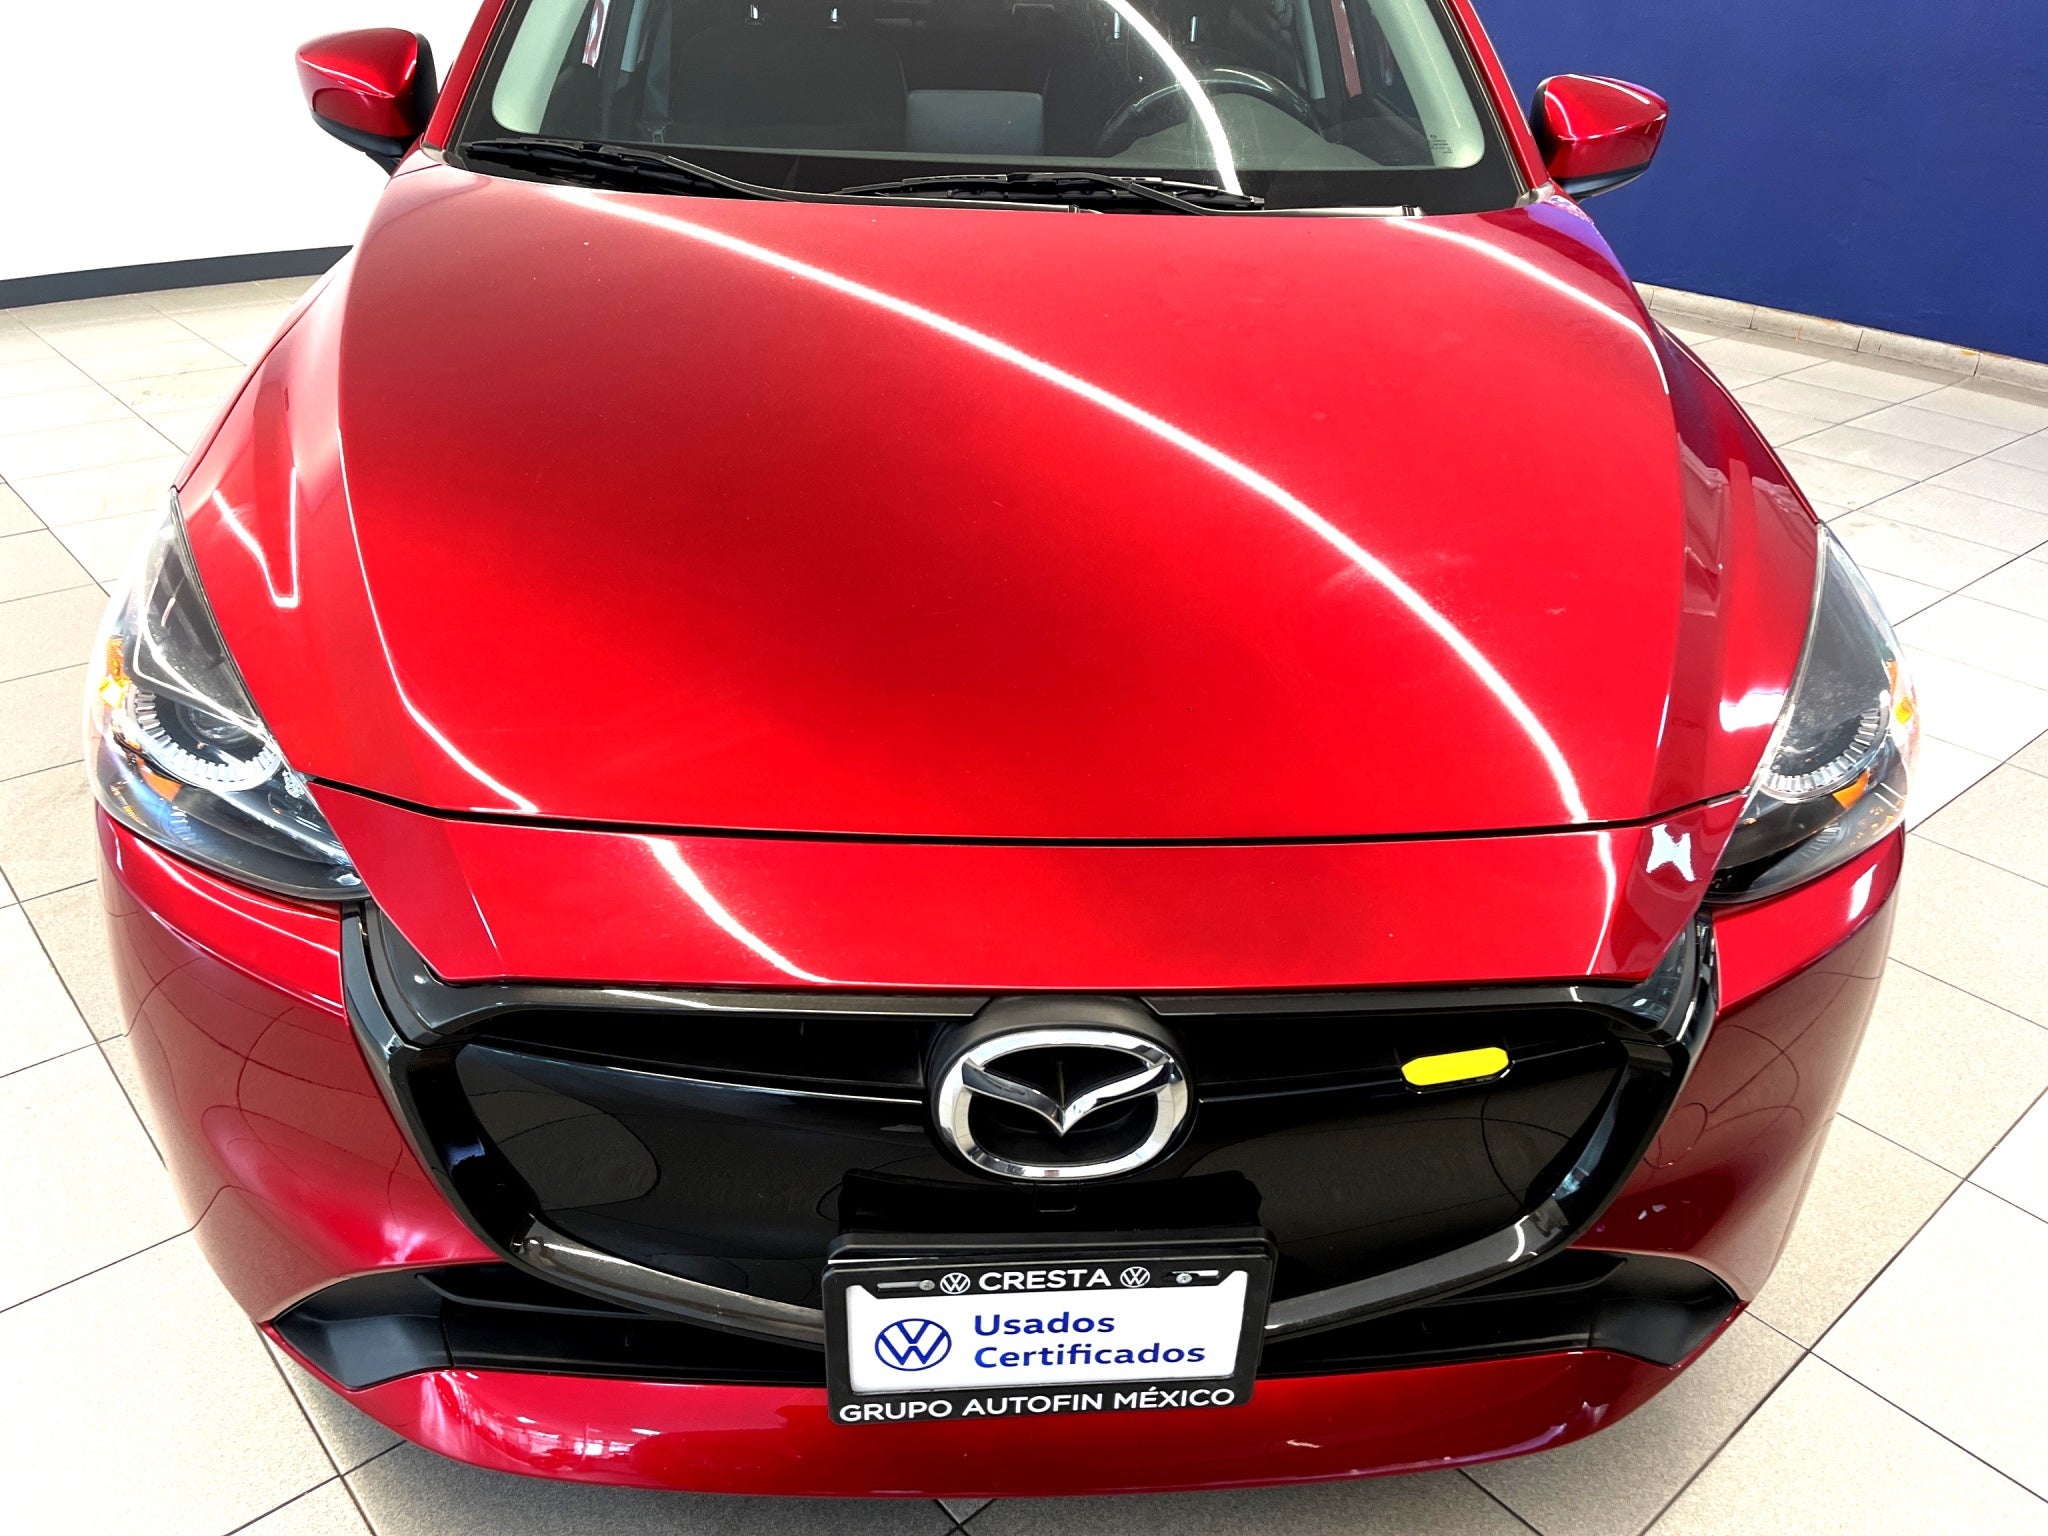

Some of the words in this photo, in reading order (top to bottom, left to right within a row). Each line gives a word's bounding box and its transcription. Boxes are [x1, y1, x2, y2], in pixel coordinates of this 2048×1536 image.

[978, 1269, 1112, 1291] CRESTA
[974, 1312, 1115, 1336] Usados
[974, 1343, 1206, 1369] Certificados
[839, 1399, 953, 1423] GRUPO
[962, 1392, 1104, 1416] AUTOFIN
[1114, 1386, 1235, 1410] MÉXICO
